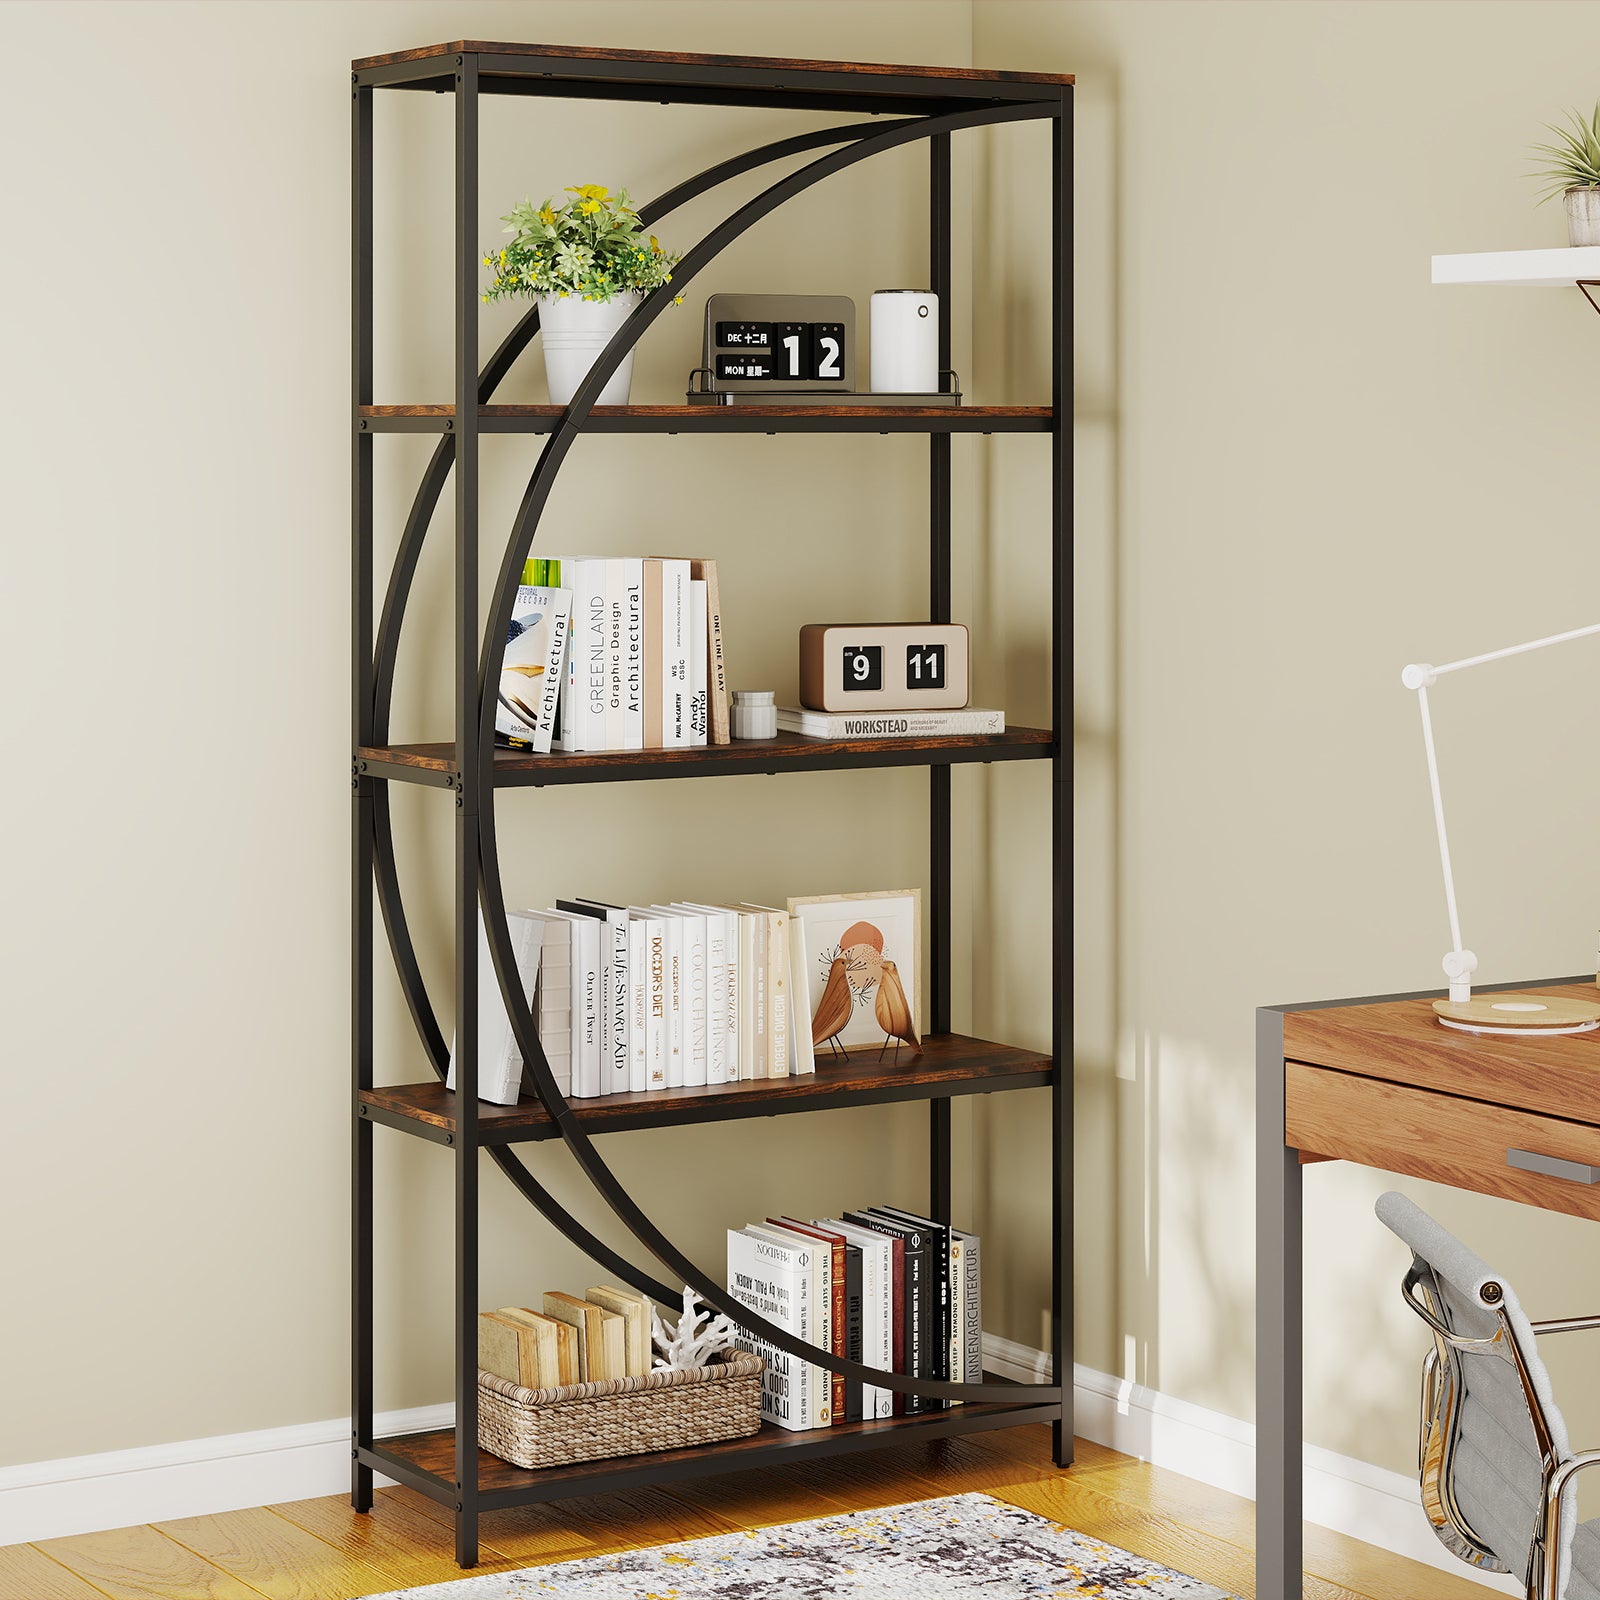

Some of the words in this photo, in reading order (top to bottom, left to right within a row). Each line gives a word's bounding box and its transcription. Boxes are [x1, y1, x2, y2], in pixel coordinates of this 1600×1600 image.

[727, 333, 742, 343] DEC
[744, 333, 767, 344] 十二月
[783, 335, 799, 376] 1
[819, 337, 840, 377] 2
[725, 366, 744, 375] MON
[610, 602, 621, 649] Design
[590, 596, 604, 714] GREENLAND
[628, 584, 639, 712] Architectural
[540, 613, 567, 731] Architectural
[672, 665, 677, 677] WS
[853, 655, 870, 681] 9
[909, 653, 938, 679] 11
[610, 655, 621, 708] Graphic
[690, 696, 700, 731] Andy
[698, 690, 706, 737] Warhol
[845, 719, 908, 735] WORKSTEAD
[711, 938, 723, 953] BE
[586, 971, 596, 1010] OLIVER
[712, 964, 724, 1002] TWO
[652, 994, 663, 1019] DIET
[586, 1013, 596, 1046] TWIST
[692, 996, 704, 1066] CHANEL
[757, 1244, 791, 1263] PHAIDON
[735, 1272, 753, 1290] ARDEN.
[754, 1279, 768, 1296] PAUL
[769, 1282, 775, 1298] by
[760, 1298, 778, 1313] world's
[777, 1287, 789, 1303] book
[850, 1296, 860, 1313] arts
[780, 1305, 789, 1320] The
[967, 1248, 980, 1378] INNENARCHITEKTUR
[774, 1353, 789, 1377] IT'S
[769, 1373, 789, 1398] GOOD
[761, 1391, 773, 1413] NO
[775, 1397, 789, 1420] IT'S
